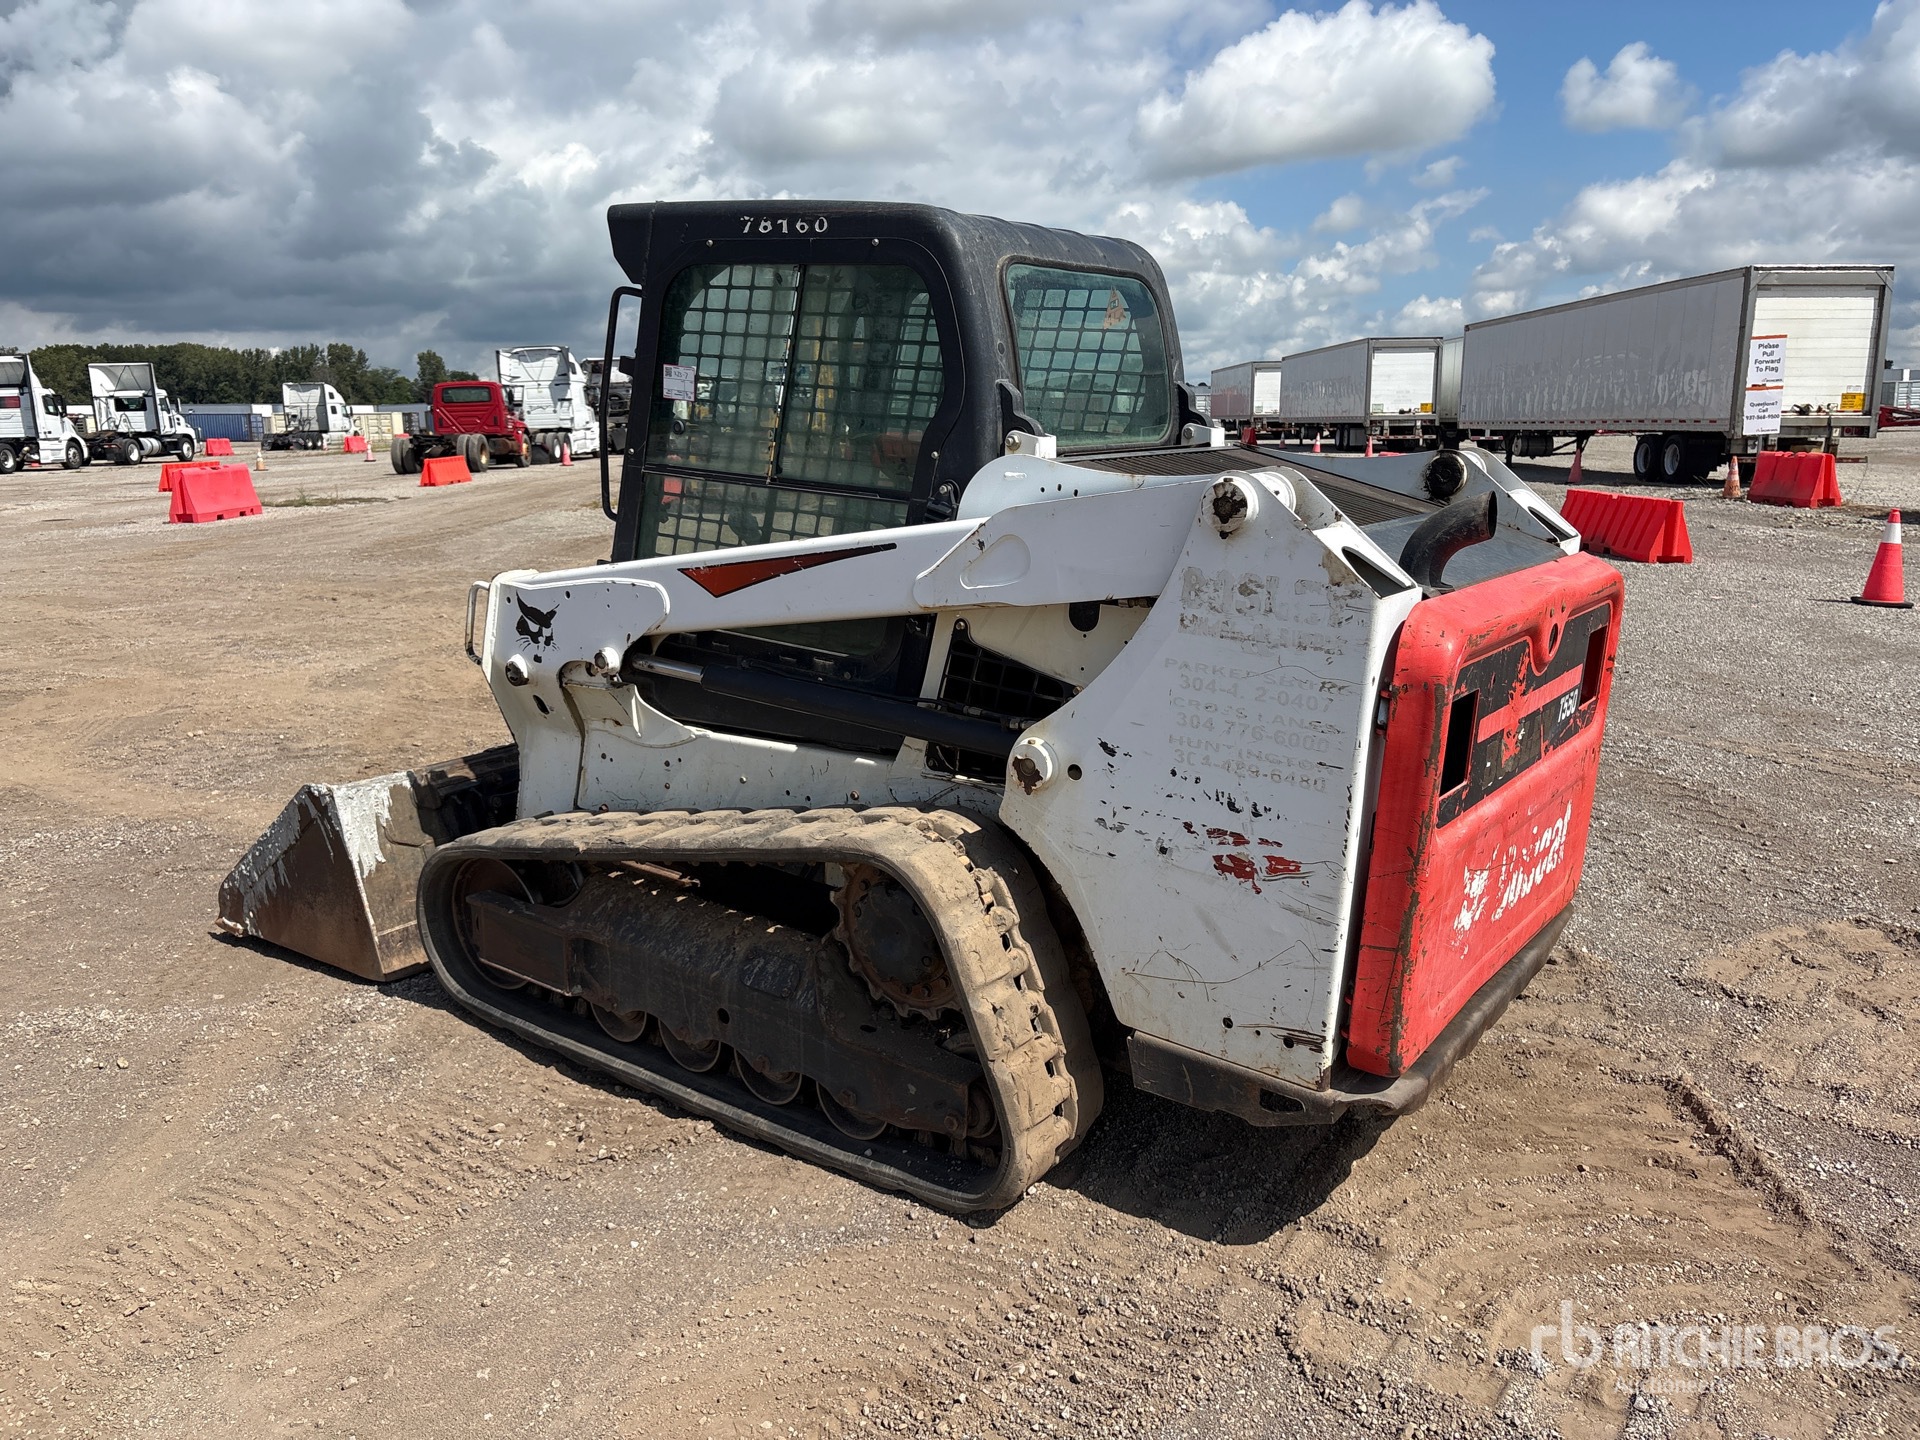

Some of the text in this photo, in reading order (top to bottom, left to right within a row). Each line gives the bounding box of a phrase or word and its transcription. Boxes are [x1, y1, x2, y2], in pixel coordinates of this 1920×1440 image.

[740, 215, 829, 234] 78160
[1758, 342, 1780, 350] Please
[1754, 357, 1781, 365] Forward
[1764, 365, 1779, 373] Flag
[1557, 689, 1579, 723] T550
